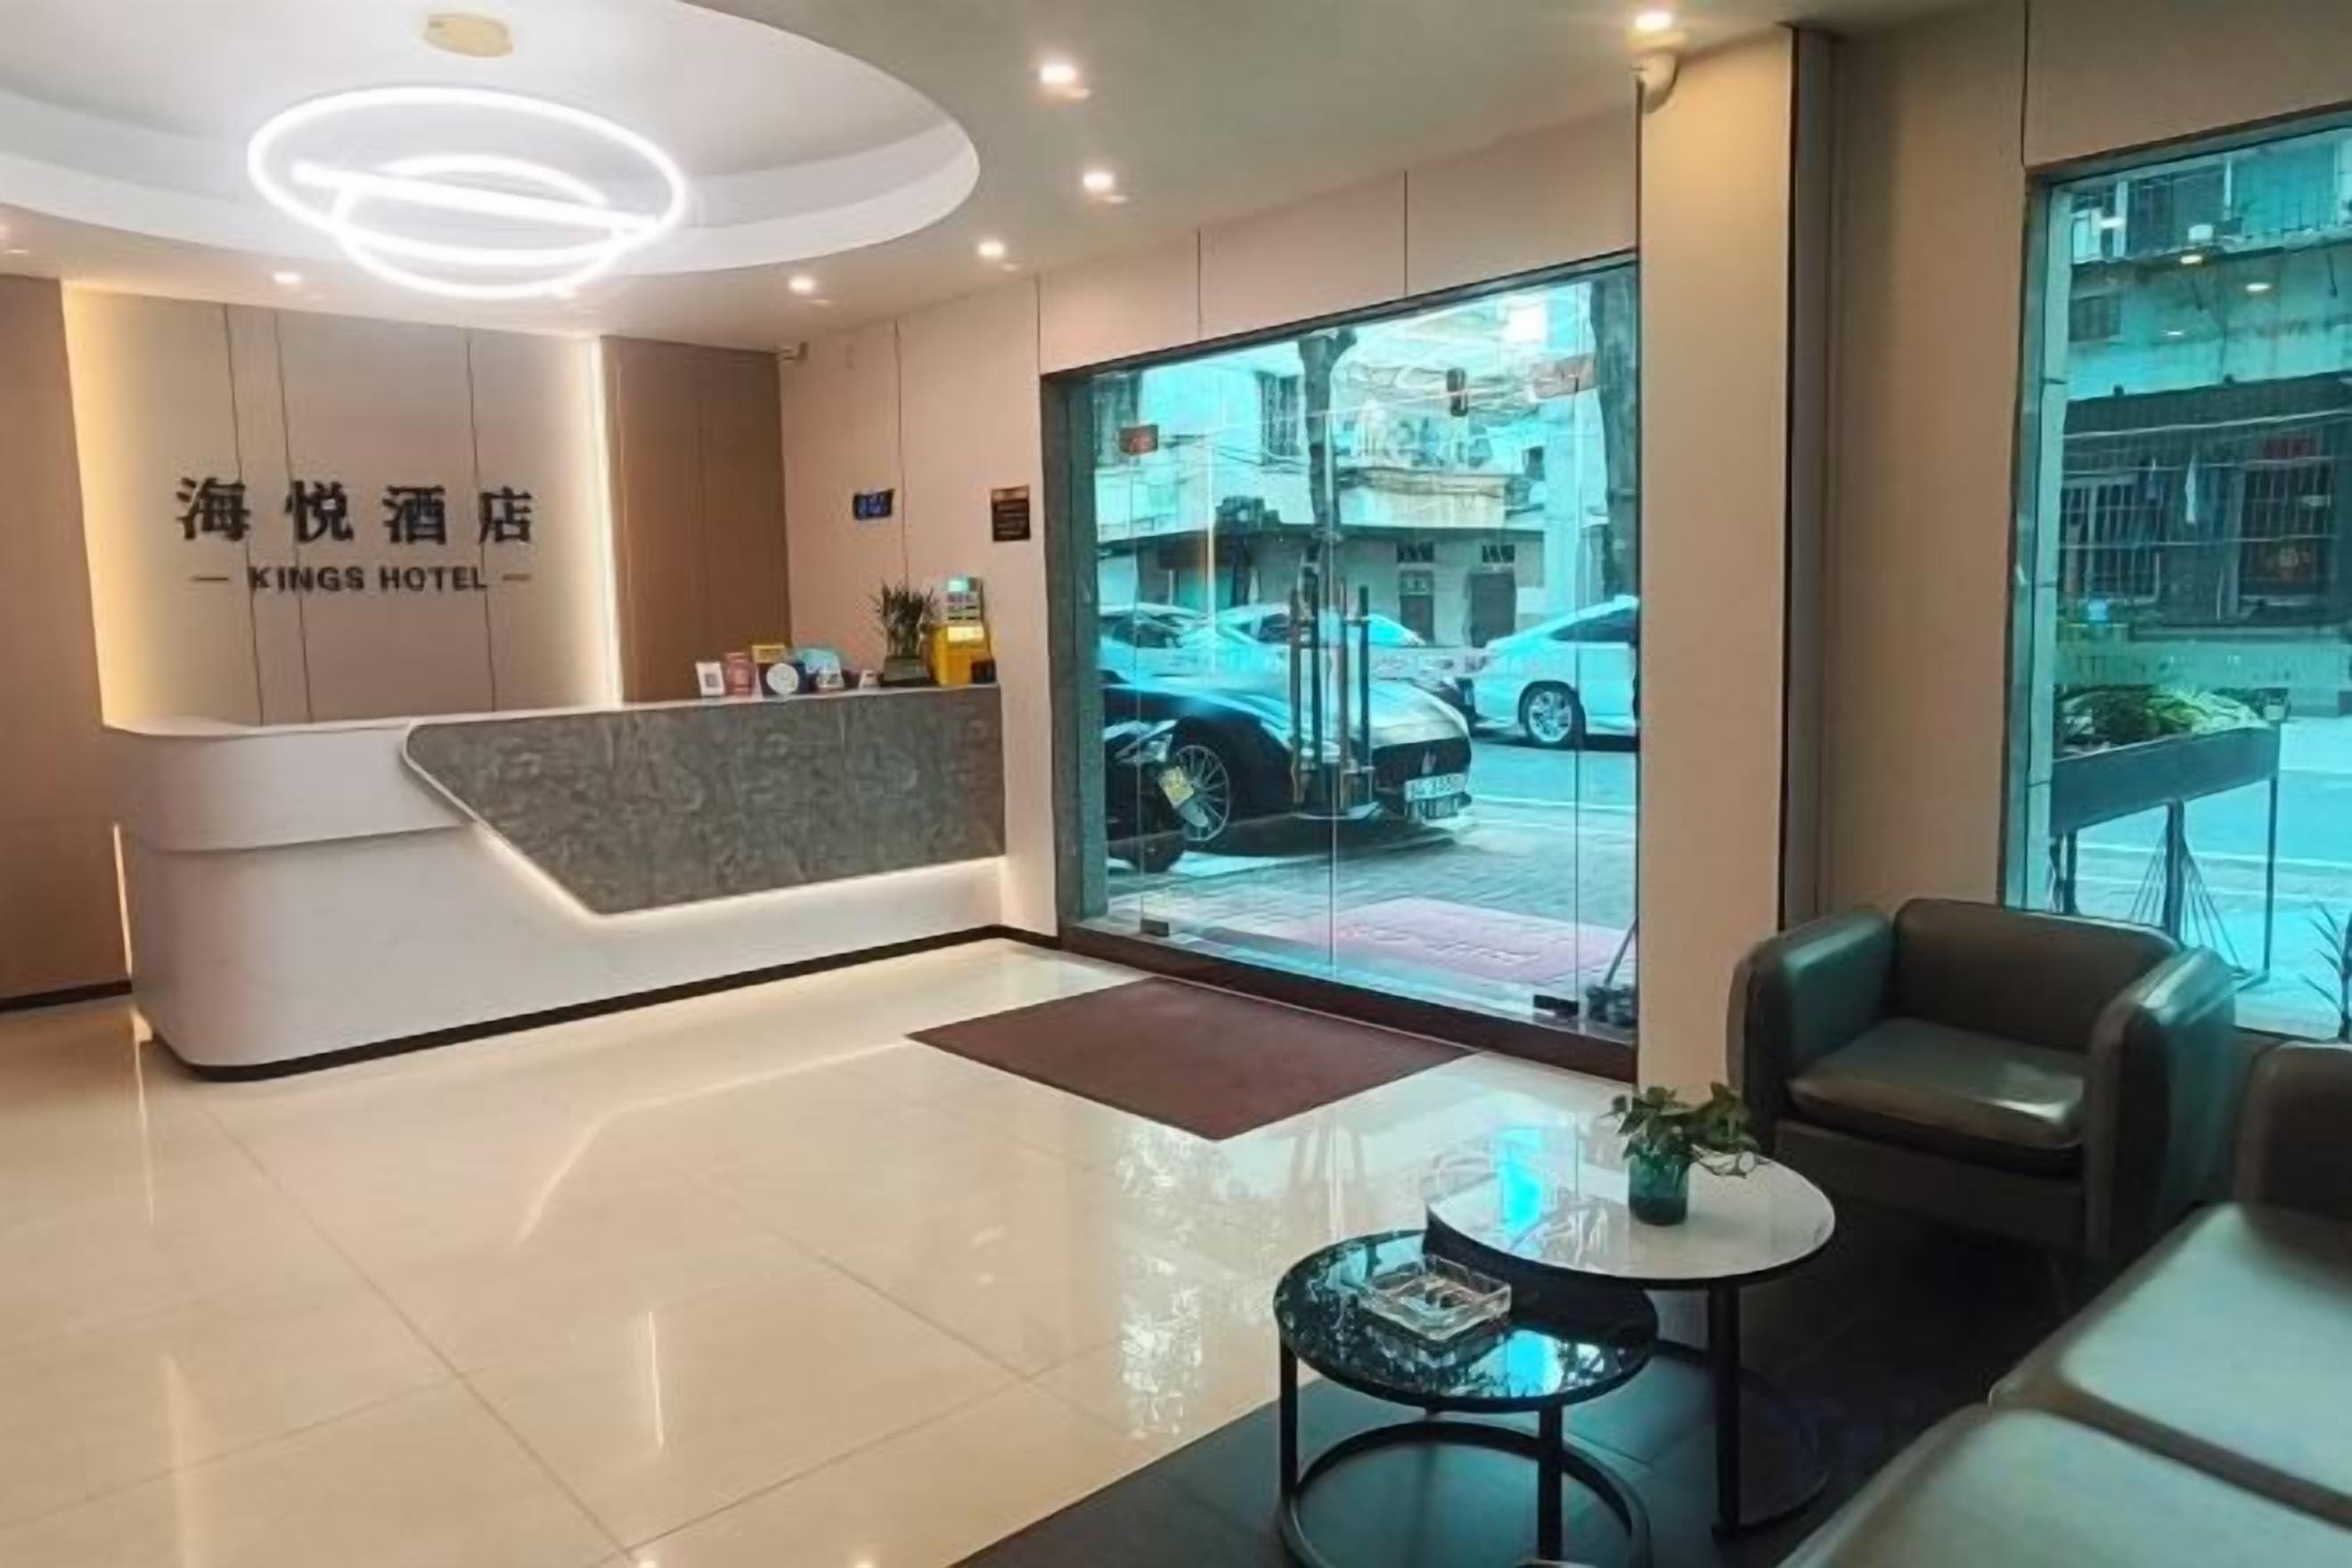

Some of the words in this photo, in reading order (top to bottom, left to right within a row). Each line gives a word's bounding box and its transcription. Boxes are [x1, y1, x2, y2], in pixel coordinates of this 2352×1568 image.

[176, 477, 533, 545] 海悦酒店
[249, 566, 365, 592] KINGS
[379, 567, 488, 592] HOTEL
